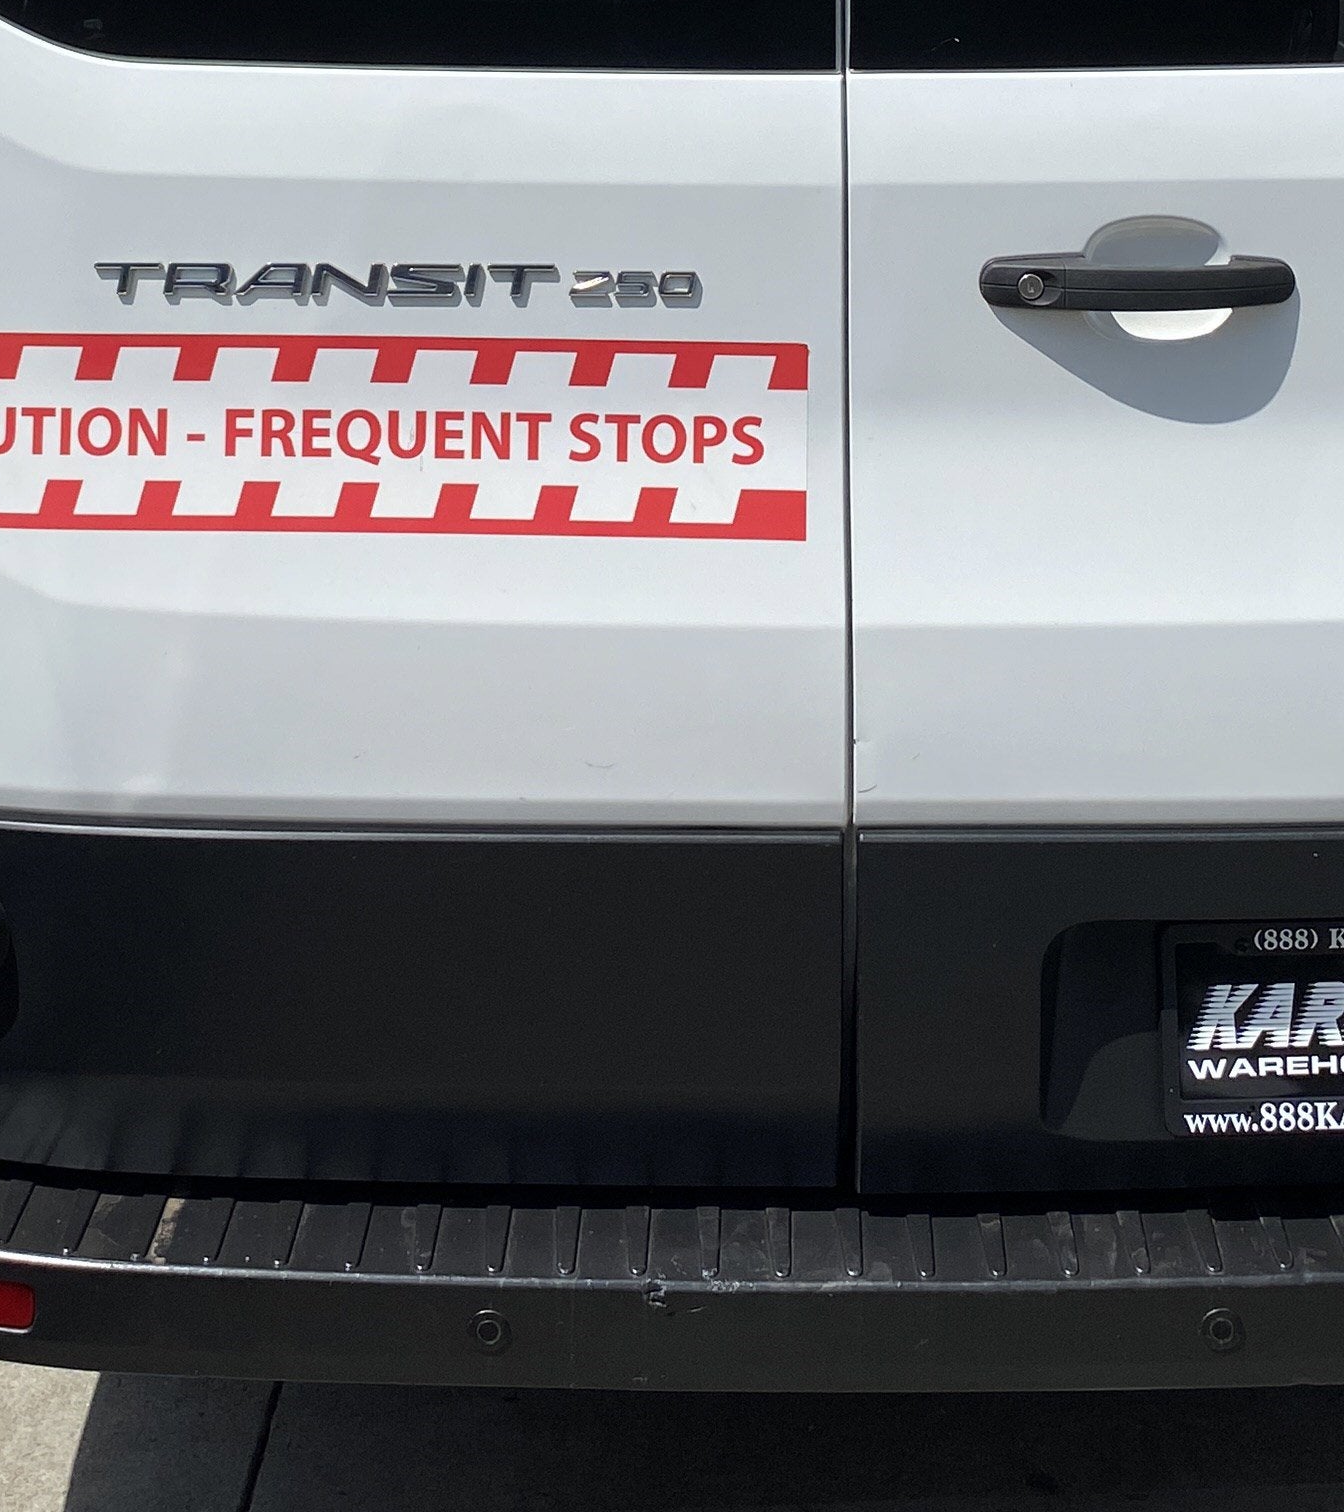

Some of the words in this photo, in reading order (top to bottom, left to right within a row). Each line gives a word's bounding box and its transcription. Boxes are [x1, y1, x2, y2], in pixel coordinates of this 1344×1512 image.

[94, 261, 557, 306] TRANSIT
[568, 269, 703, 307] 250
[223, 407, 552, 467] FREQUENT
[568, 411, 766, 466] STOPS
[1253, 928, 1319, 952] (888)
